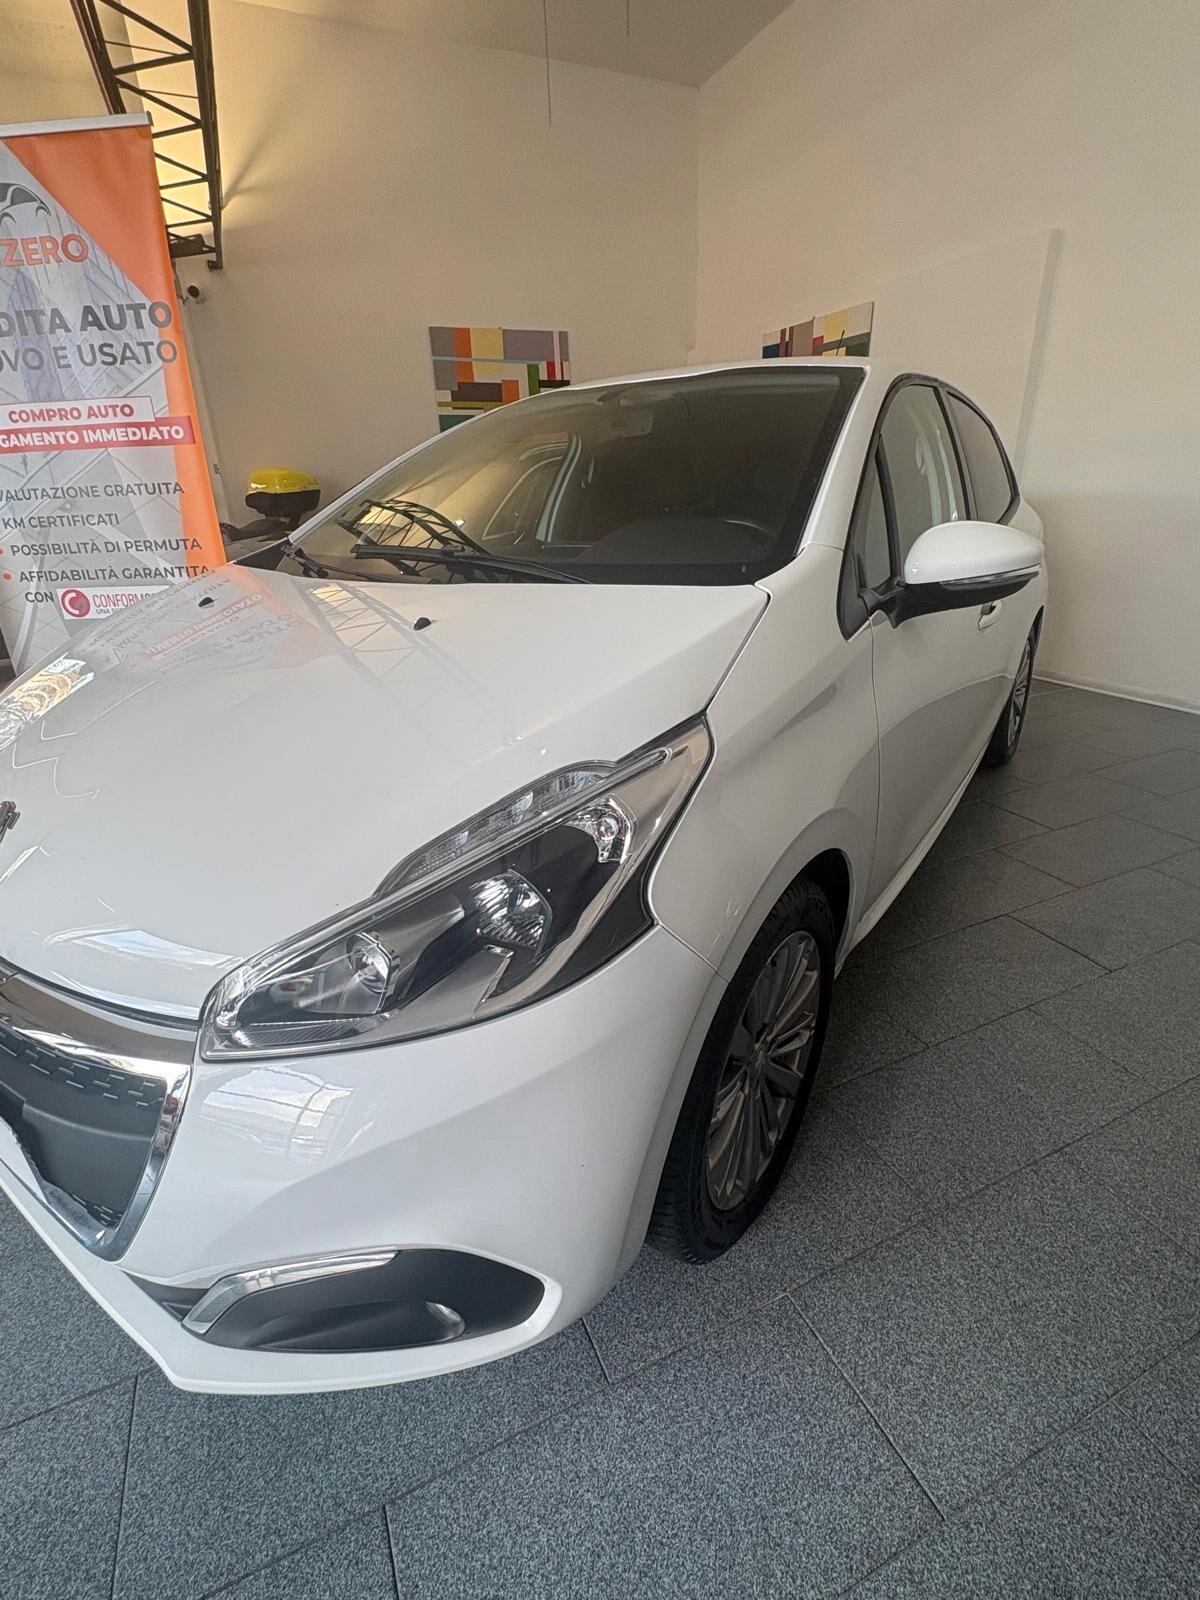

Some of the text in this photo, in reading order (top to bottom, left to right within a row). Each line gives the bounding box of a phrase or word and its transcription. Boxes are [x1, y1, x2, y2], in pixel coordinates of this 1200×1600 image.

[0, 233, 89, 267] ZERO
[80, 301, 172, 332] AUTO
[0, 340, 177, 373] VO E USATO
[8, 404, 135, 424] COMPRO AUTO
[0, 425, 184, 448] GAMENTO IMMEDIATO
[103, 481, 185, 498] GRATUITA
[2, 513, 120, 530] KM CERTIFICATI
[11, 538, 202, 556] POSSIBILITÀ DI PERMUTA
[19, 564, 118, 582] AFFIDABILITÀ
[25, 591, 54, 603] CON
